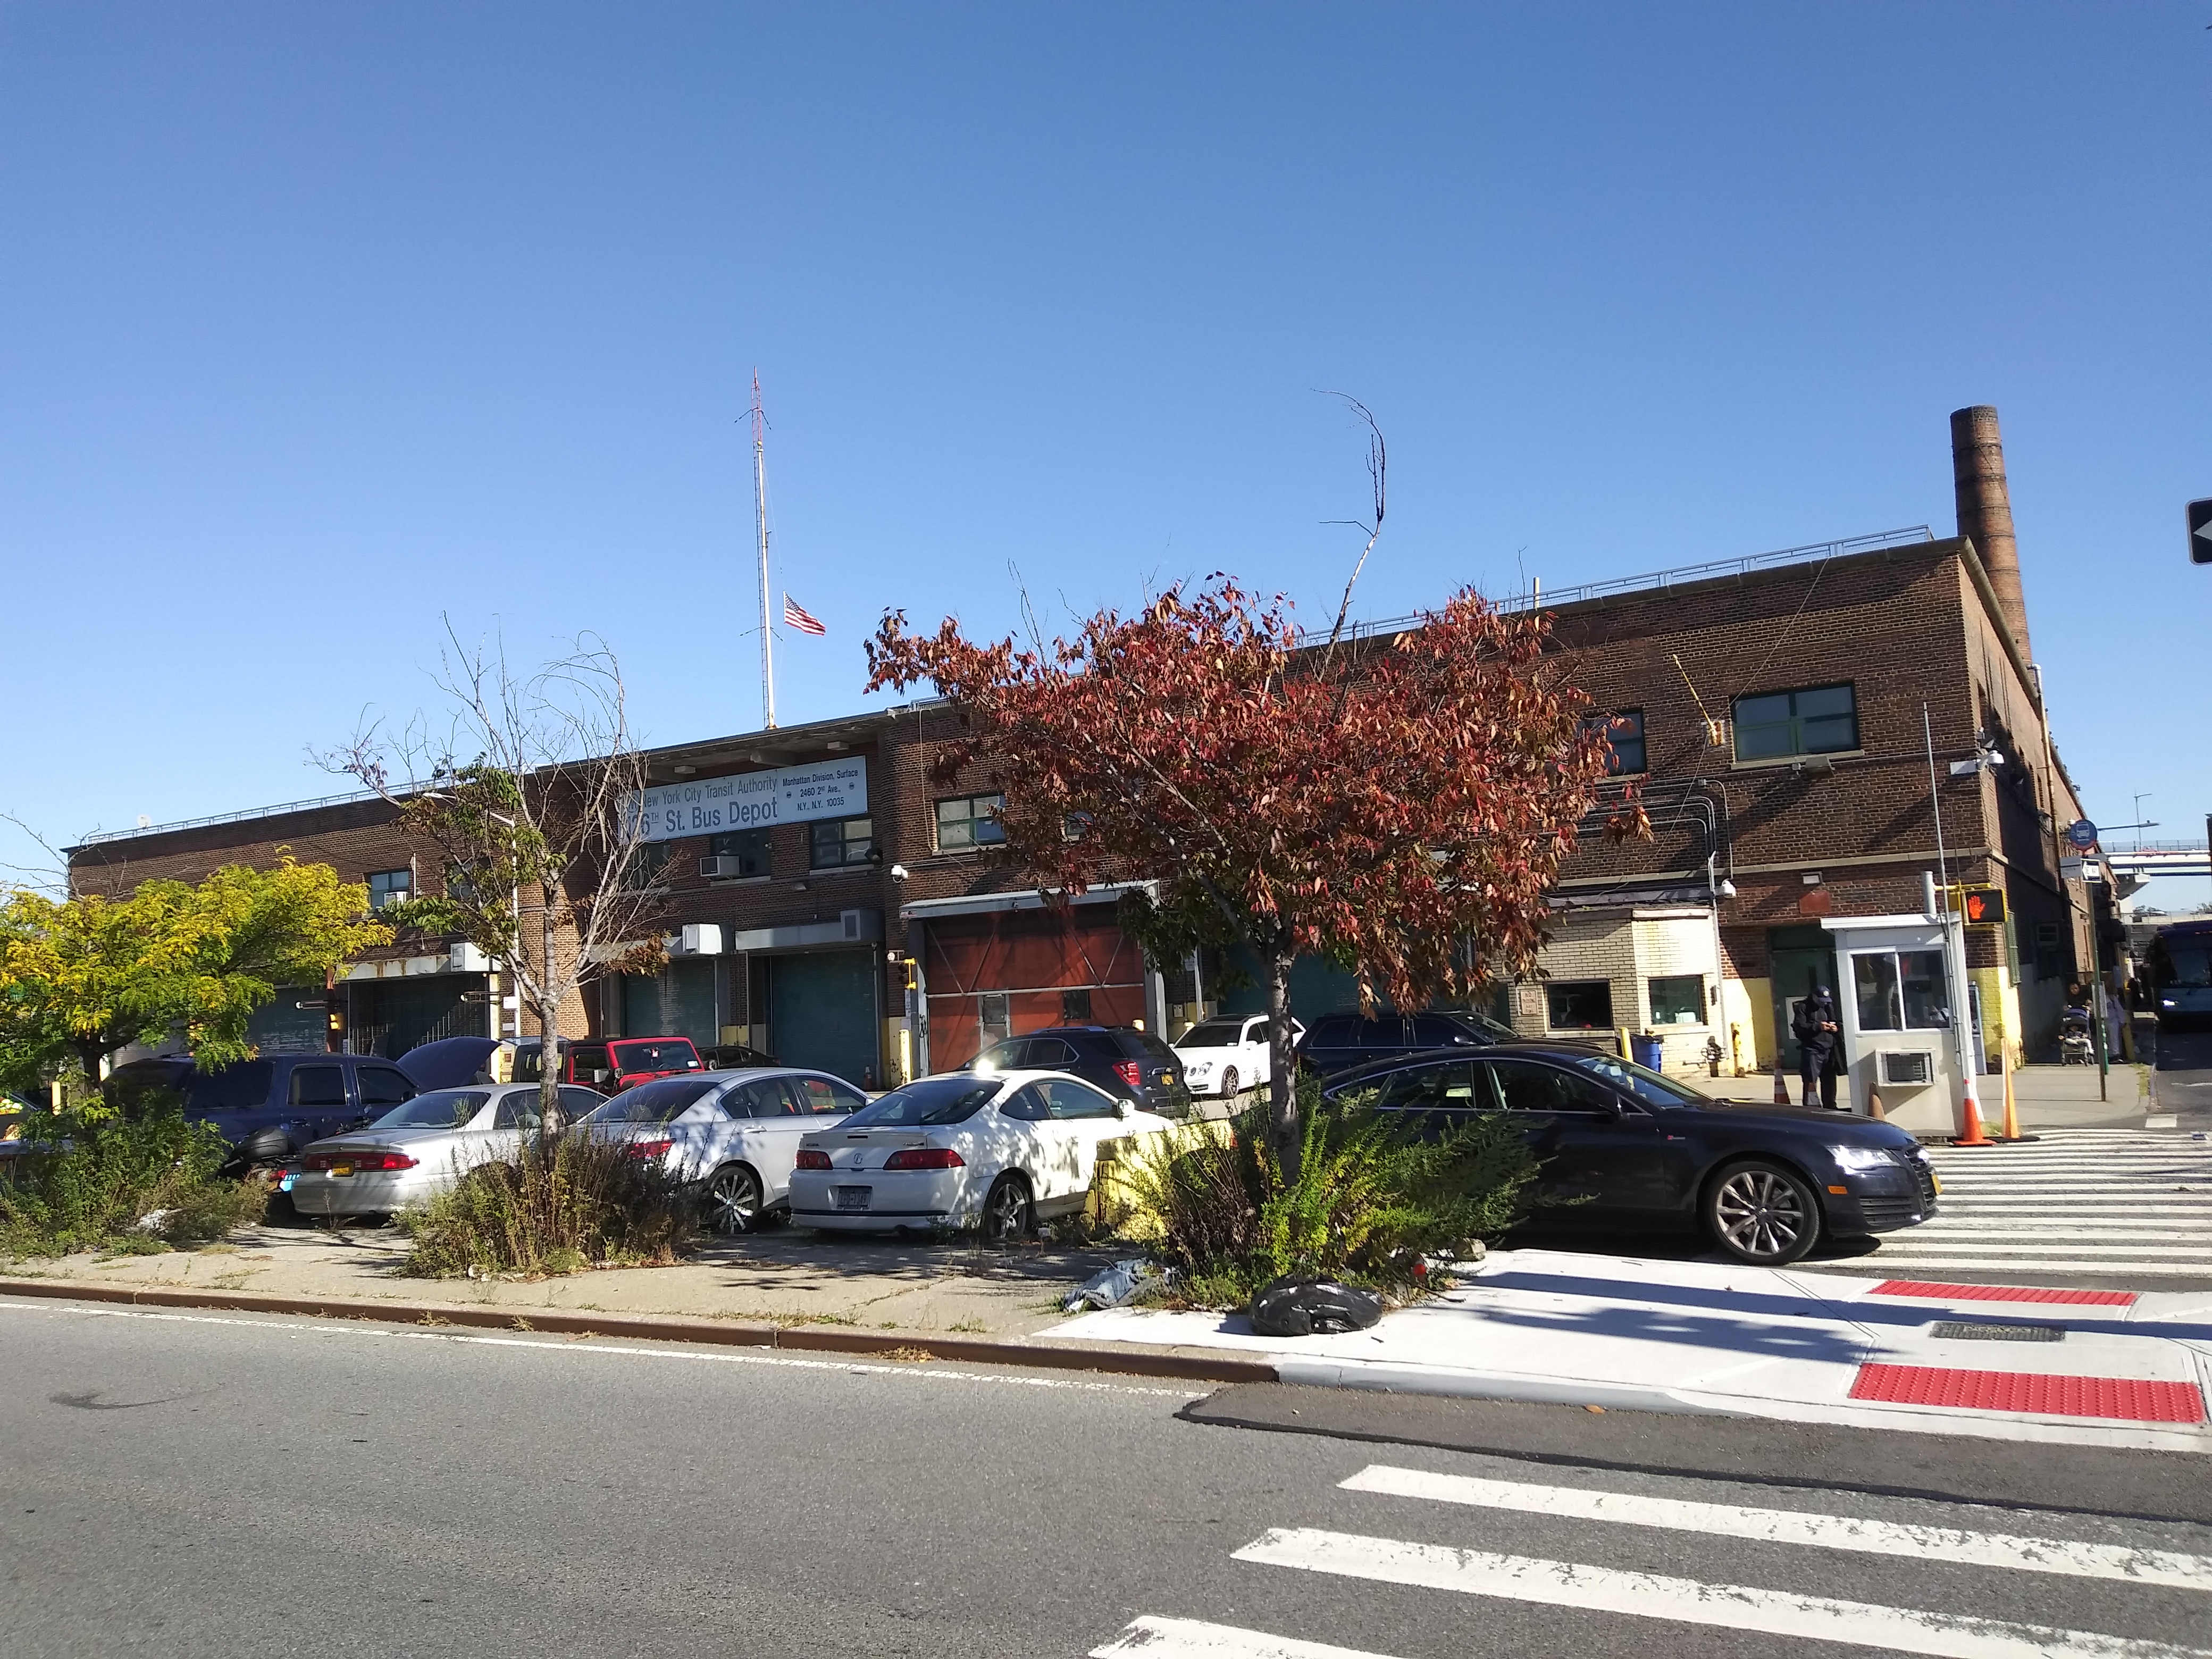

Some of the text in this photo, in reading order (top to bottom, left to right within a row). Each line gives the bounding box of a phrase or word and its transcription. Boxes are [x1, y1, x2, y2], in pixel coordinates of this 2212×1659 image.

[783, 769, 858, 786] Manhattan Division, Surface
[663, 791, 681, 805] York
[685, 787, 701, 803] City
[706, 783, 733, 799] Transit
[738, 775, 777, 794] Authority
[800, 788, 815, 798] 2460
[812, 800, 823, 809] N.Y.
[826, 797, 844, 807] 10035
[666, 809, 685, 832] St.
[692, 806, 721, 829] Bus
[729, 797, 777, 825] Depot
